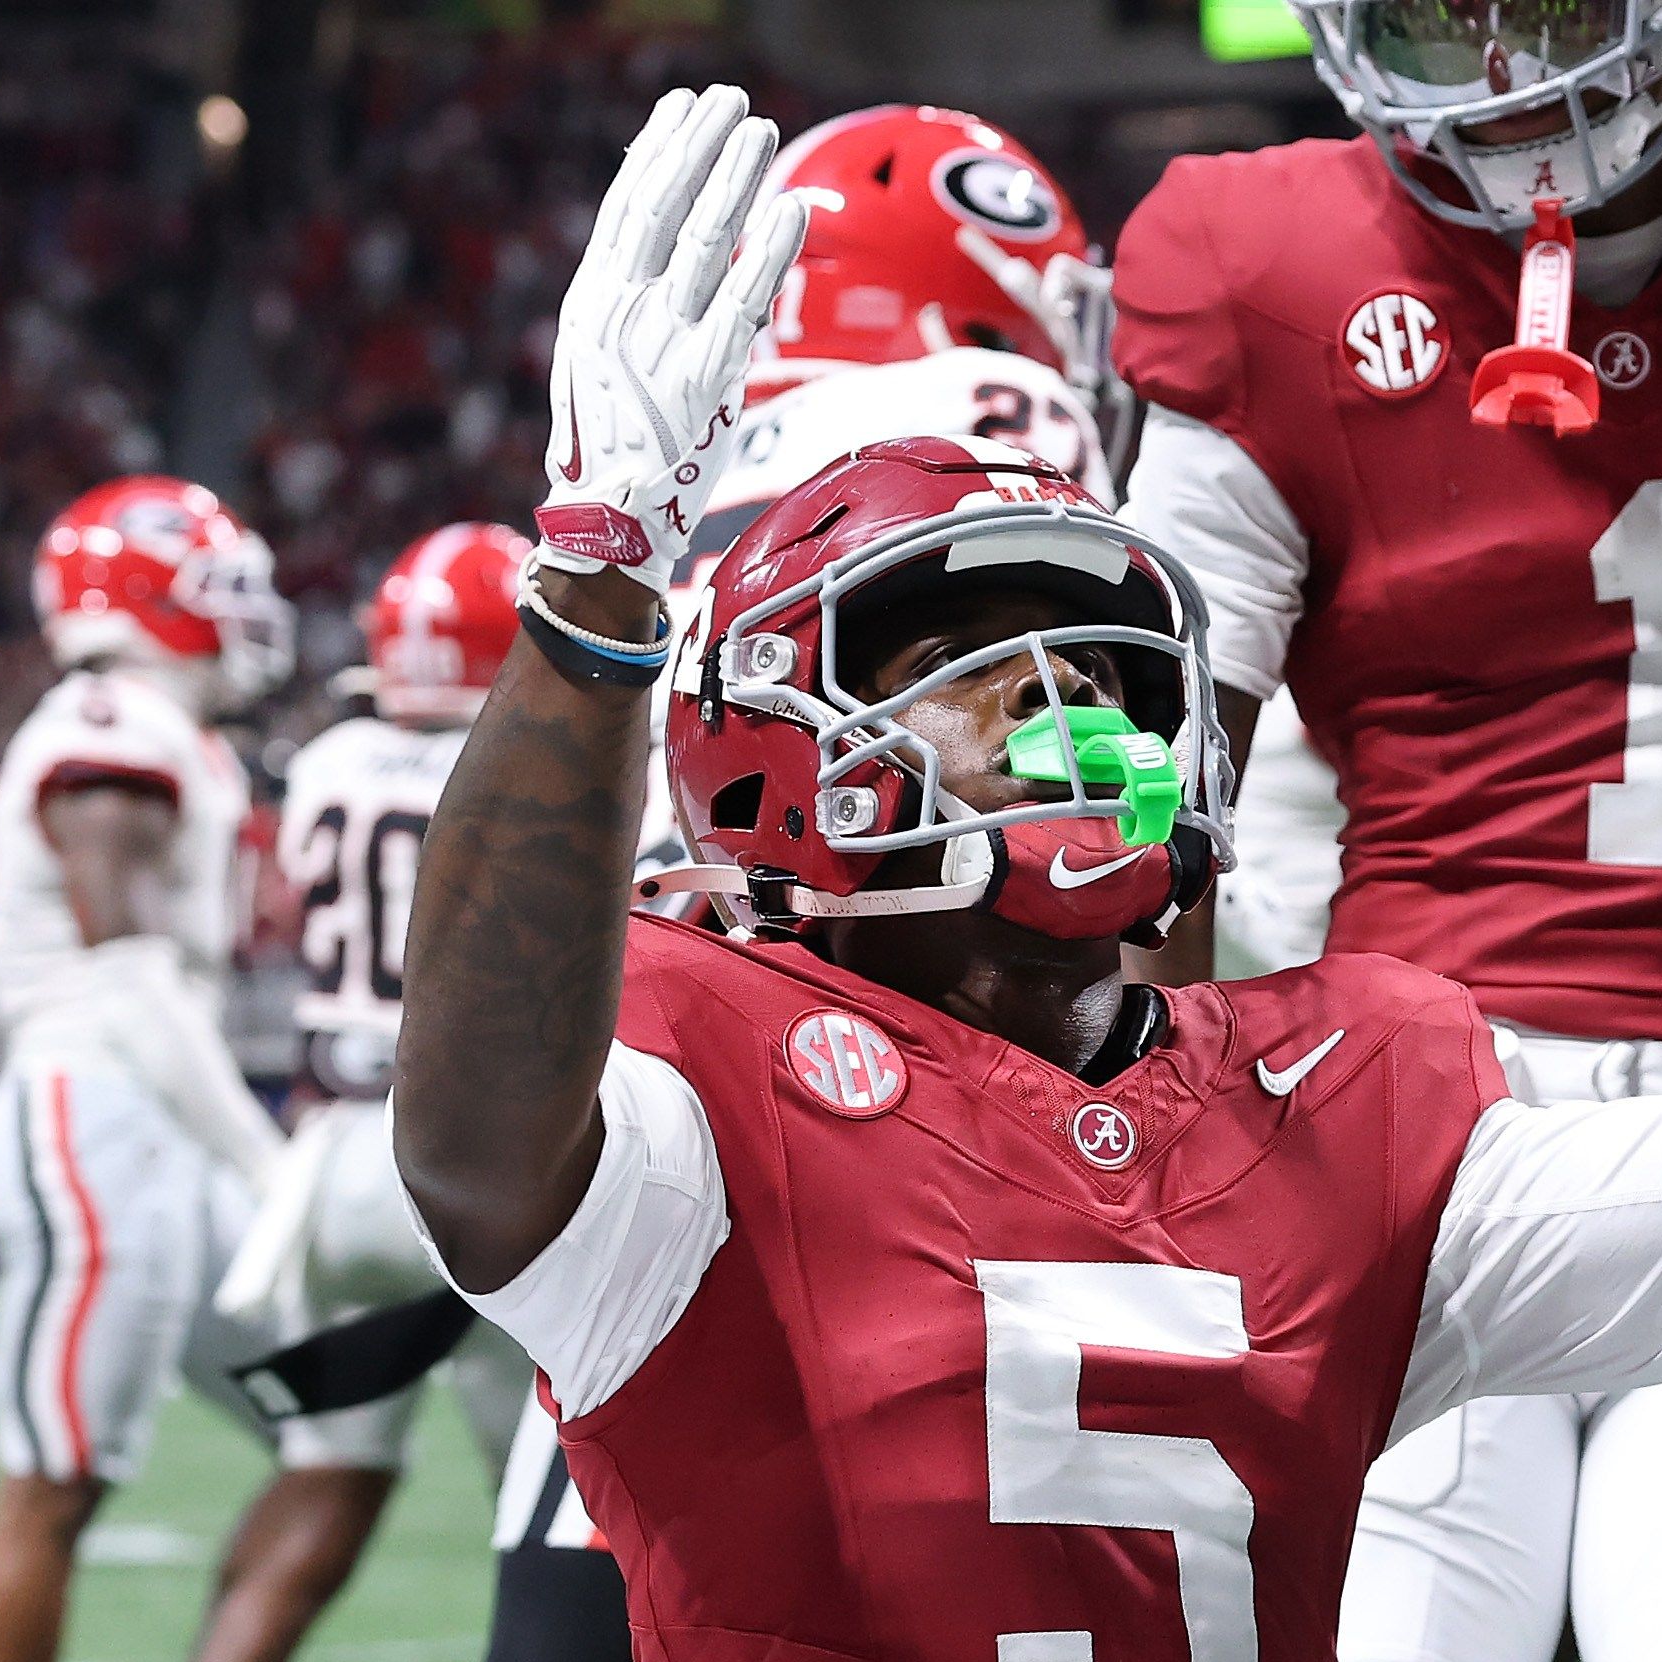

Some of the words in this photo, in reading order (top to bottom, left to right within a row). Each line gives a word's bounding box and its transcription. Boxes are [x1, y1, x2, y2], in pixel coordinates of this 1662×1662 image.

[1525, 159, 1559, 195] A
[1345, 293, 1443, 392] SEC
[1606, 338, 1640, 380] A
[794, 1013, 899, 1109] SEC
[1083, 1112, 1123, 1152] A
